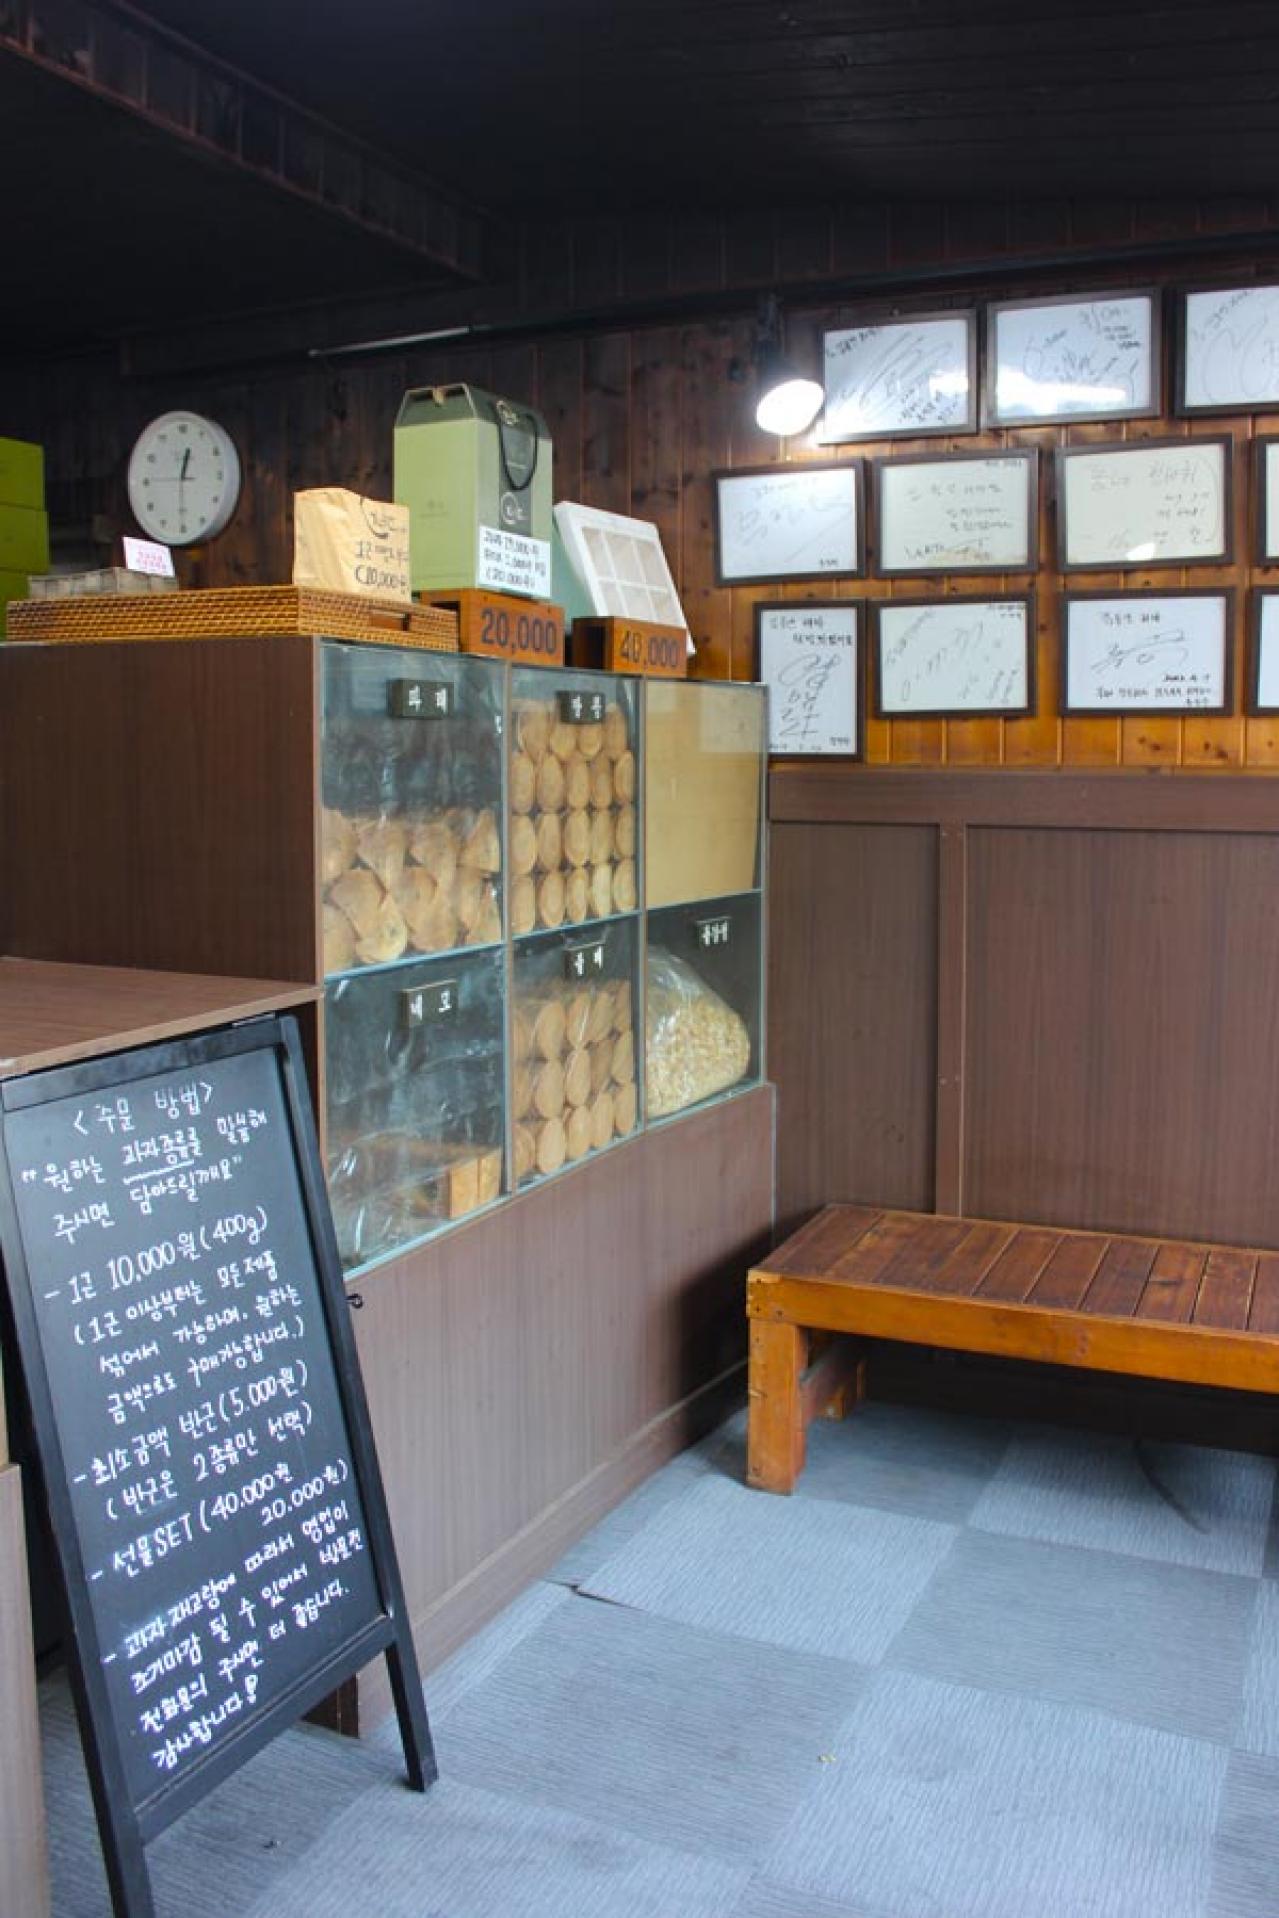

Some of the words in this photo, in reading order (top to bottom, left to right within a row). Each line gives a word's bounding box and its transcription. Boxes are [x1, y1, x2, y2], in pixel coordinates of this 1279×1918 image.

[481, 607, 557, 656] 20,000
[620, 630, 680, 668] 40,000
[52, 1201, 116, 1245] 주시면
[244, 1533, 297, 1573] 따라서
[130, 1632, 203, 1695] 조기마감
[238, 1596, 257, 1628] 수
[218, 1639, 264, 1684] 주시면
[268, 1619, 287, 1640] 더
